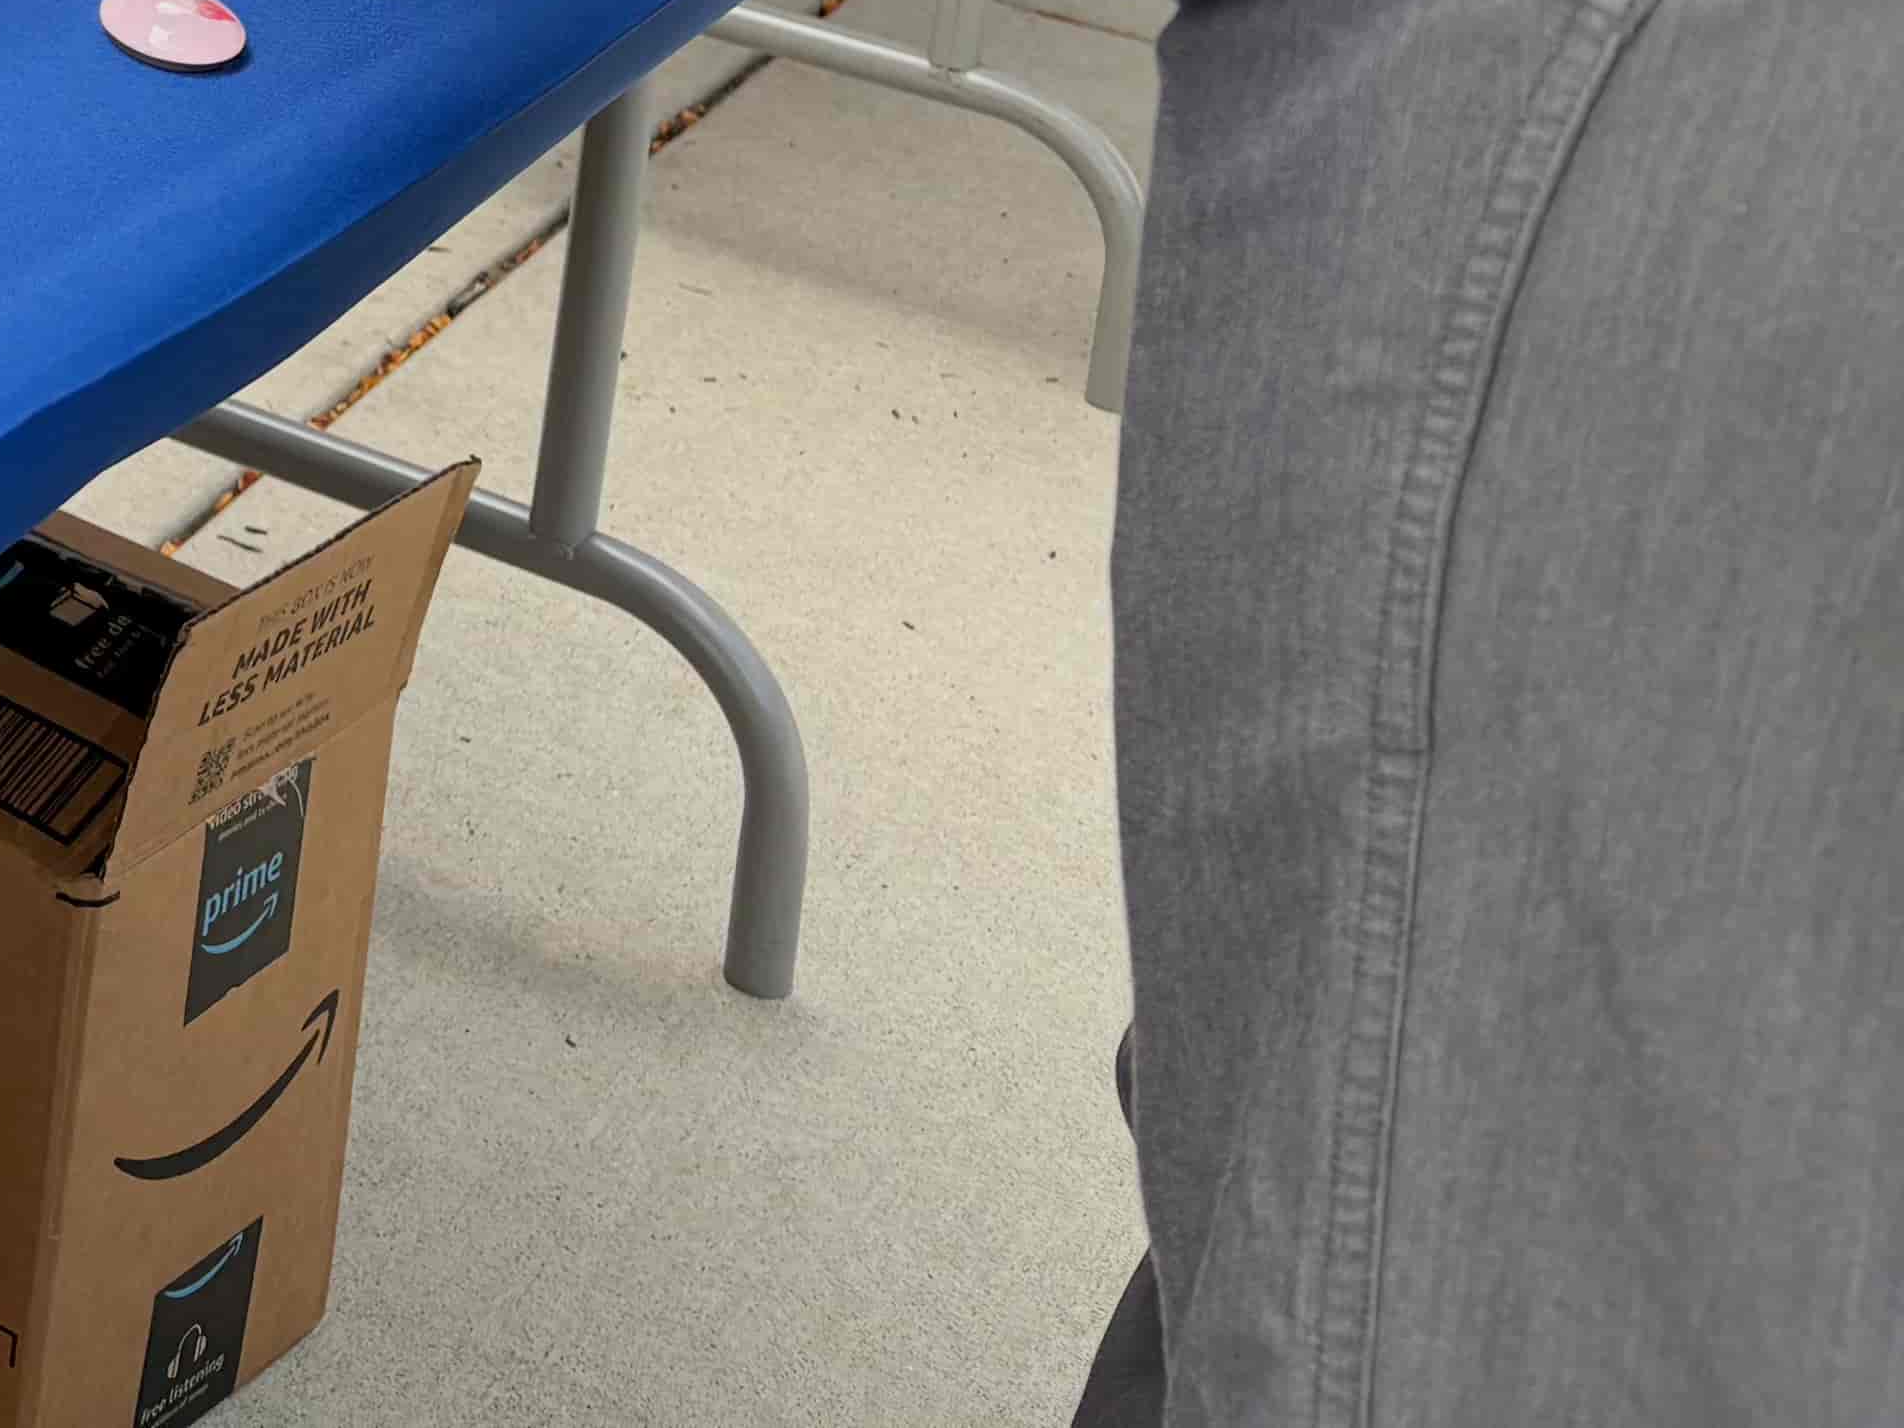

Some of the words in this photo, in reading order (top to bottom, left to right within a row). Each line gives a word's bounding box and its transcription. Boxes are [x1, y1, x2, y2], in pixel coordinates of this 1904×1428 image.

[198, 672, 259, 727] LESS
[263, 604, 375, 690] MATERIAL
[232, 617, 307, 680] MADE
[311, 578, 373, 635] WITH
[201, 851, 284, 937] prime
